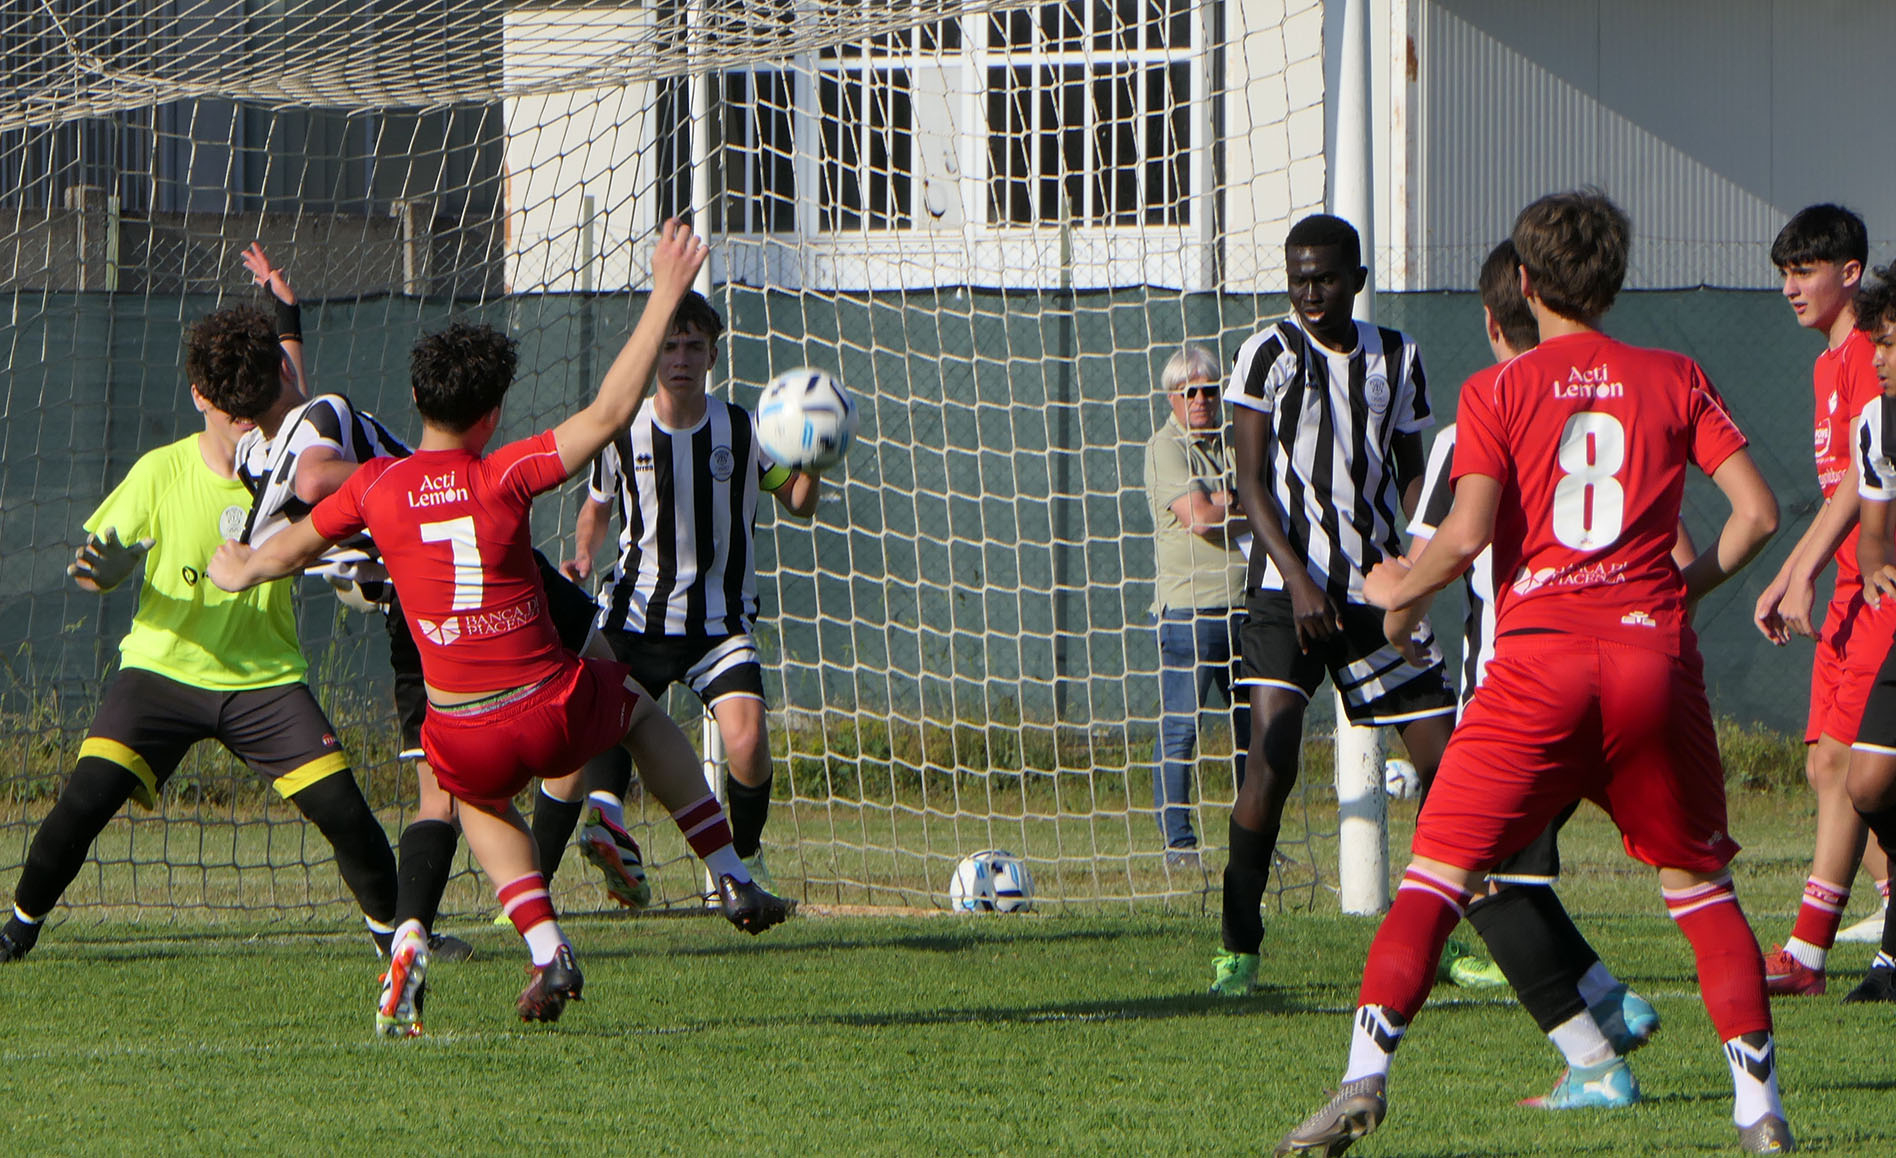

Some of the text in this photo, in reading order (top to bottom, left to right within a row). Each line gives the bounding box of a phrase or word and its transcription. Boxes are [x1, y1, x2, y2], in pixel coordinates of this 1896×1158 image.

[1568, 363, 1608, 383] Acti
[1553, 380, 1624, 399] Lemon
[419, 471, 456, 492] Acti
[1553, 411, 1625, 552] 8
[407, 487, 469, 508] Lemon
[419, 515, 484, 612] 7
[465, 606, 524, 626] BANCA
